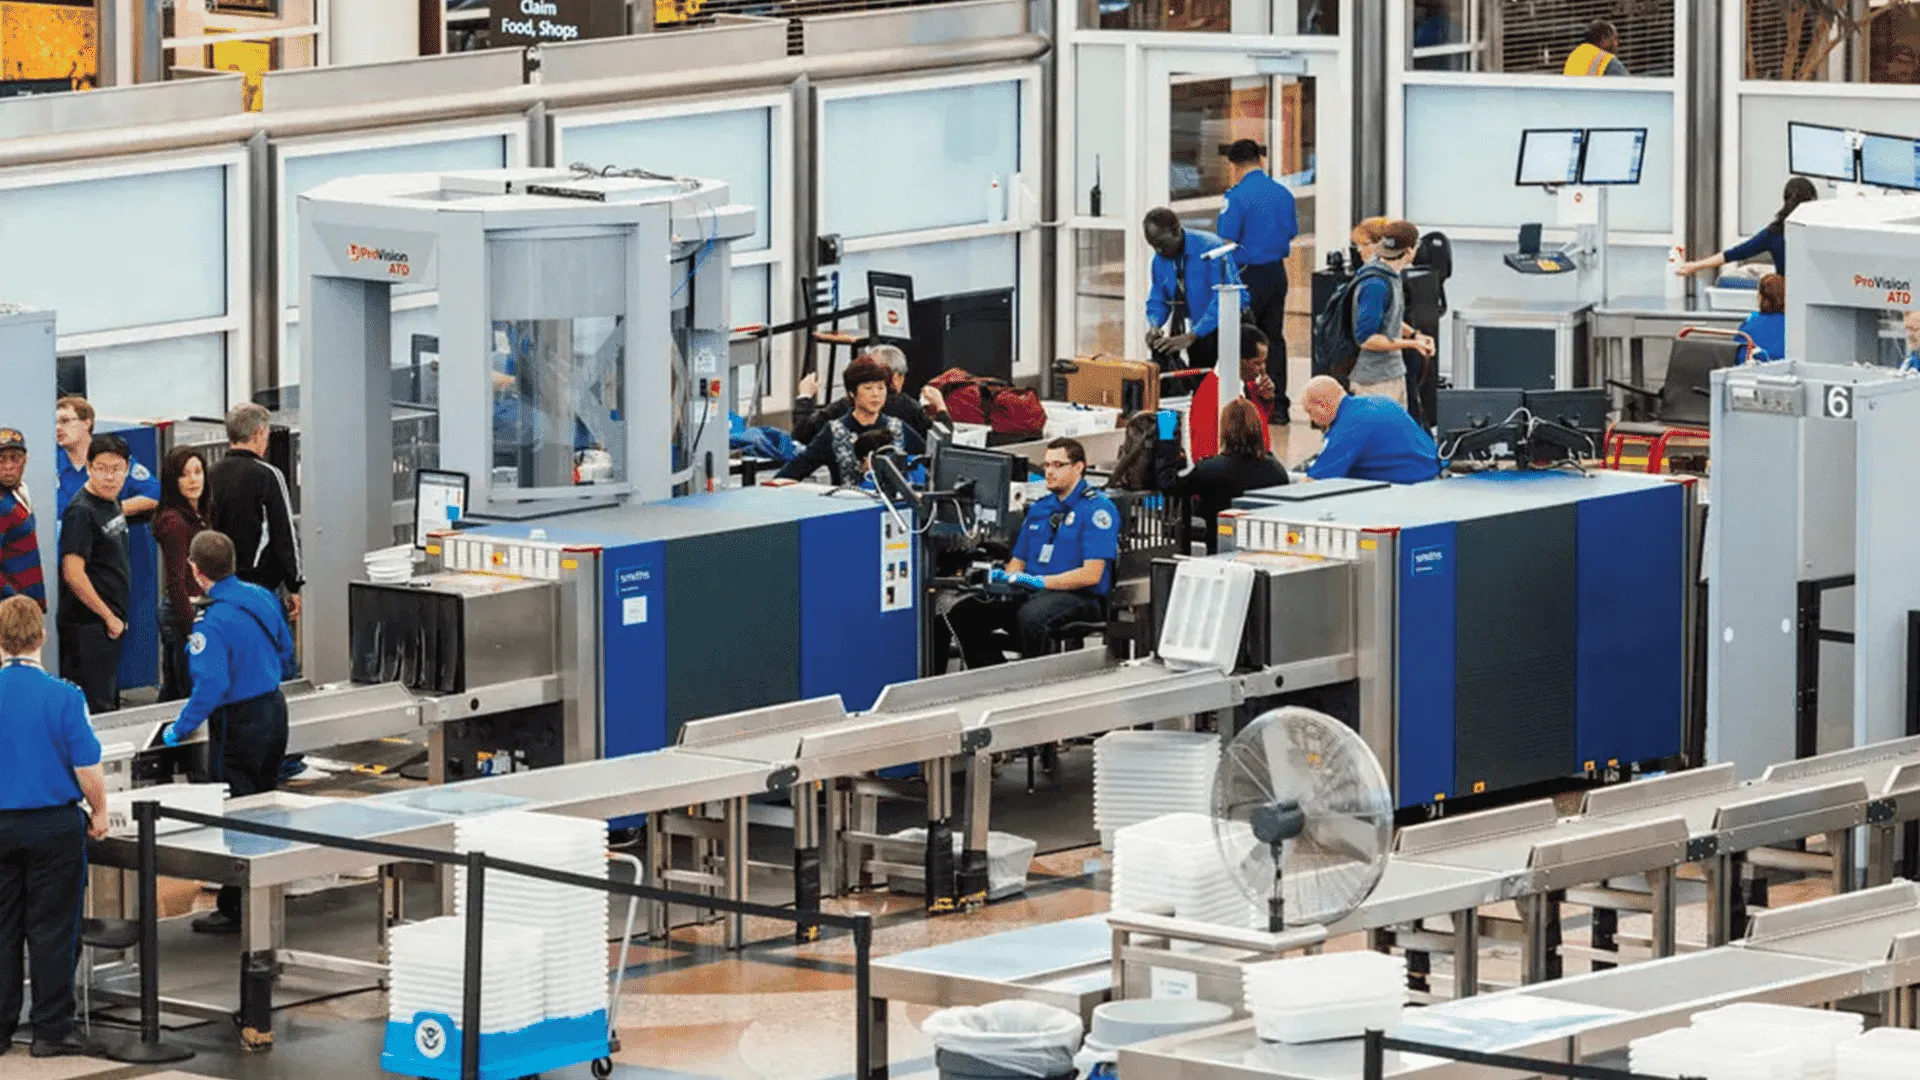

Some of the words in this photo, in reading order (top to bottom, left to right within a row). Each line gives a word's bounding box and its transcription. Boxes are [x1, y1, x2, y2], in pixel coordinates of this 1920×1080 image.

[520, 0, 557, 15] Claim
[502, 18, 536, 37] Food,
[539, 20, 578, 40] Shops
[360, 246, 408, 262] ProVision
[1854, 274, 1910, 290] ProVision
[1887, 291, 1911, 304] ATD
[1827, 386, 1849, 417] 6
